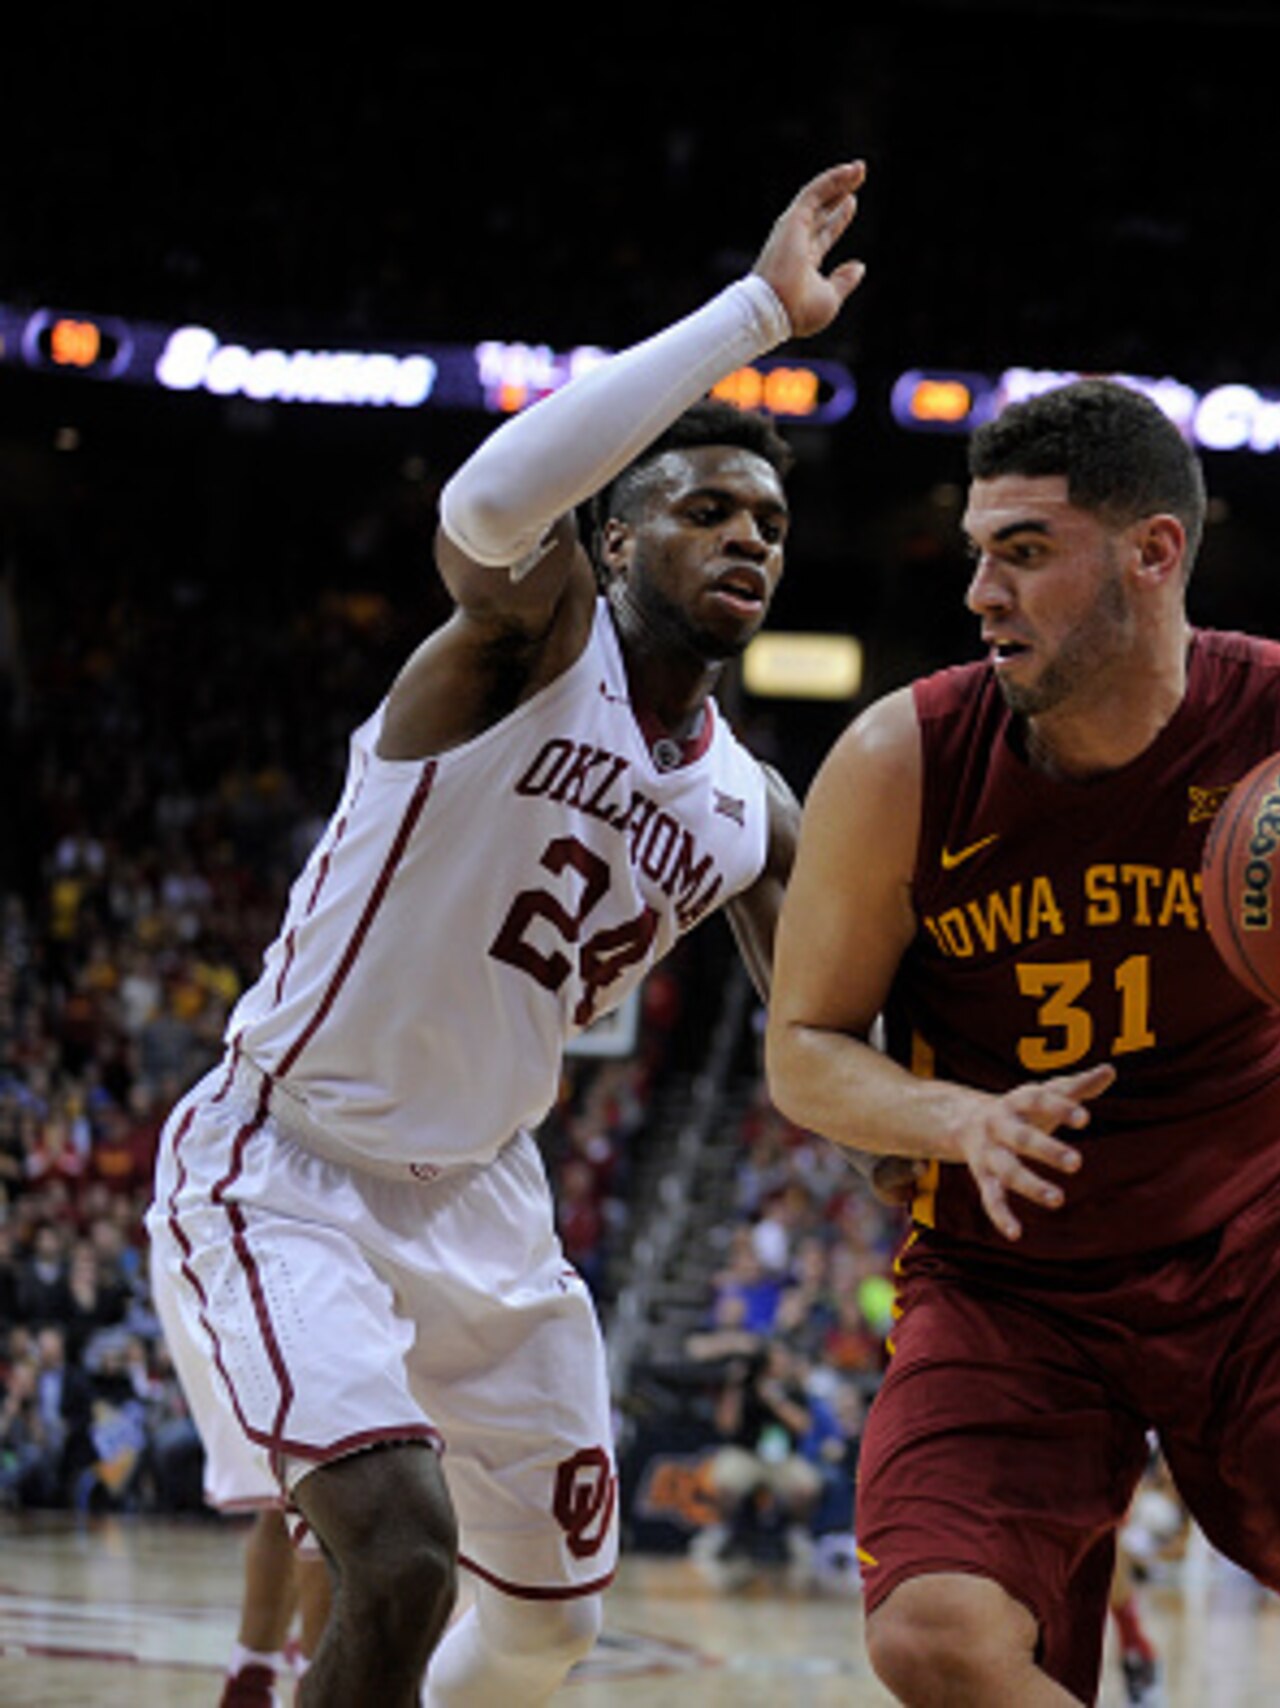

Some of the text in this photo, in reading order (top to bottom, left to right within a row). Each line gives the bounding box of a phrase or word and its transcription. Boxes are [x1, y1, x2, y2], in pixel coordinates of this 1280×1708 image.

[515, 739, 723, 930] OKLAHOMA
[924, 864, 1209, 957] IOWA STA
[489, 836, 660, 1026] 24
[1015, 953, 1156, 1072] 31
